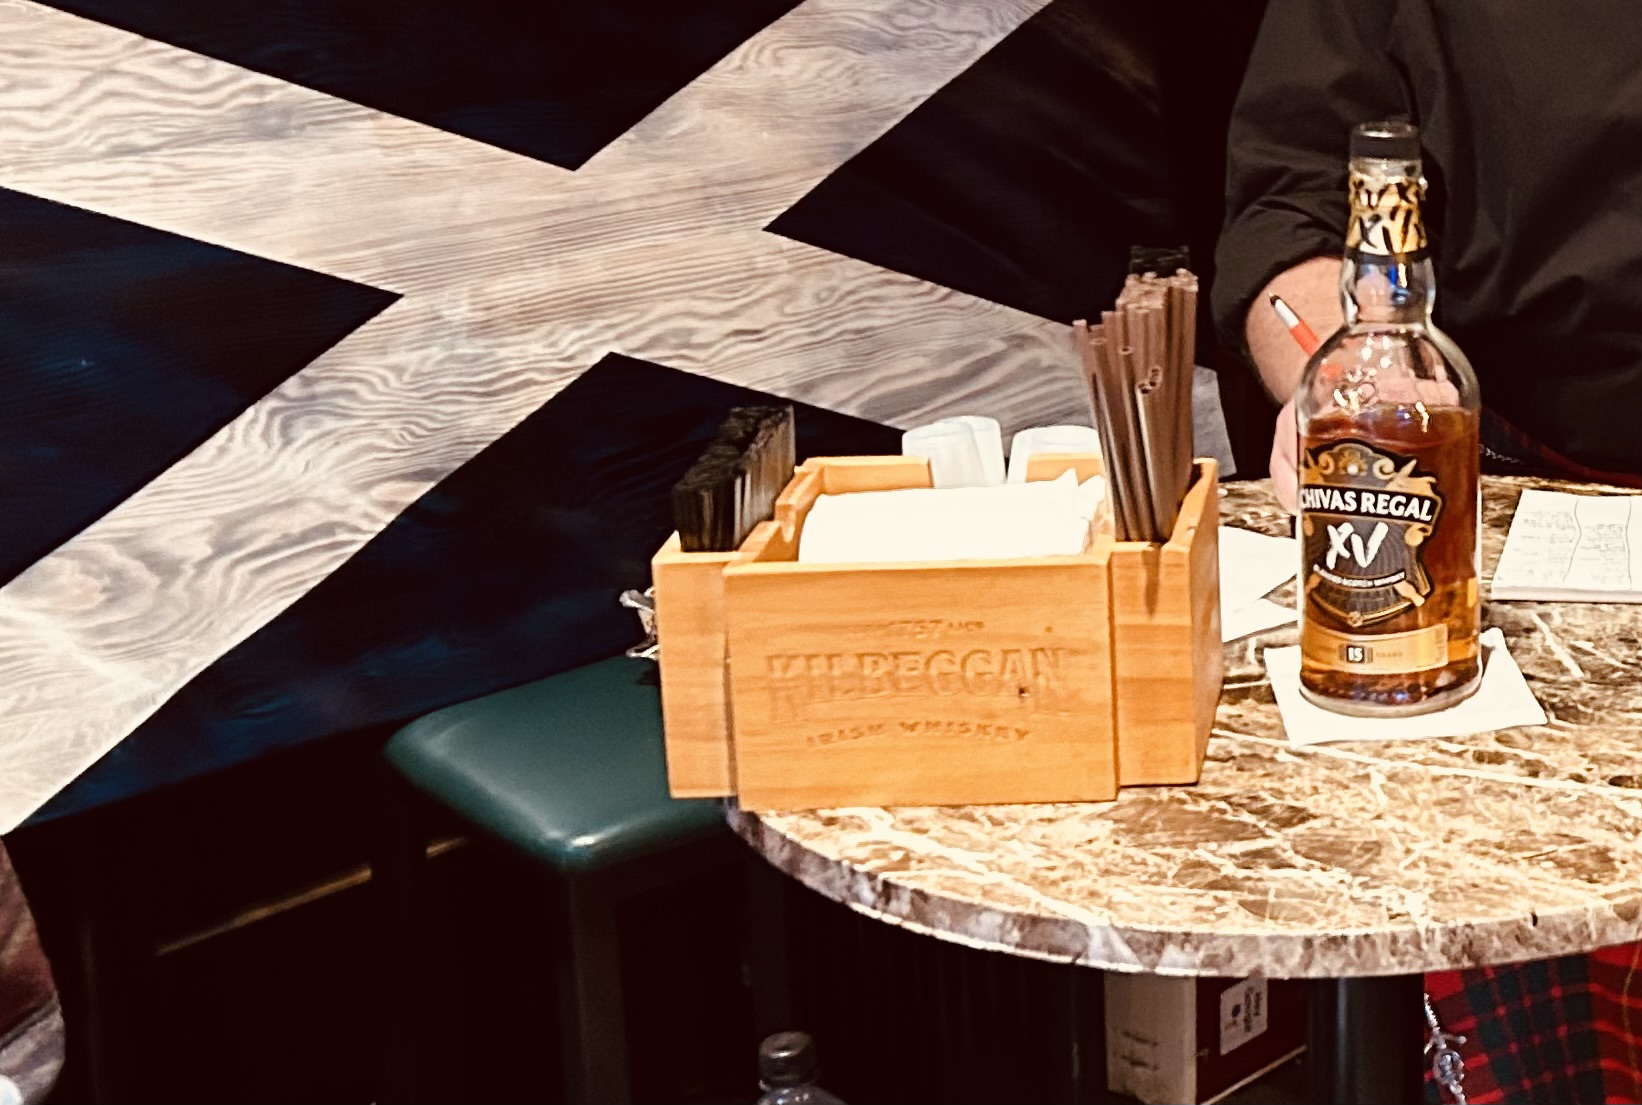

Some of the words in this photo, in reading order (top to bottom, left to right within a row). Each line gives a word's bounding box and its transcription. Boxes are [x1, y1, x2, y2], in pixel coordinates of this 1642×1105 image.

[1300, 487, 1357, 512] CHIVAS
[1360, 491, 1433, 522] REGAL
[1326, 522, 1389, 570] XV
[1348, 646, 1364, 663] 15
[765, 648, 1076, 720] KILBEGGAN
[806, 723, 886, 746] IRISH
[898, 720, 1034, 742] WHISKEY
